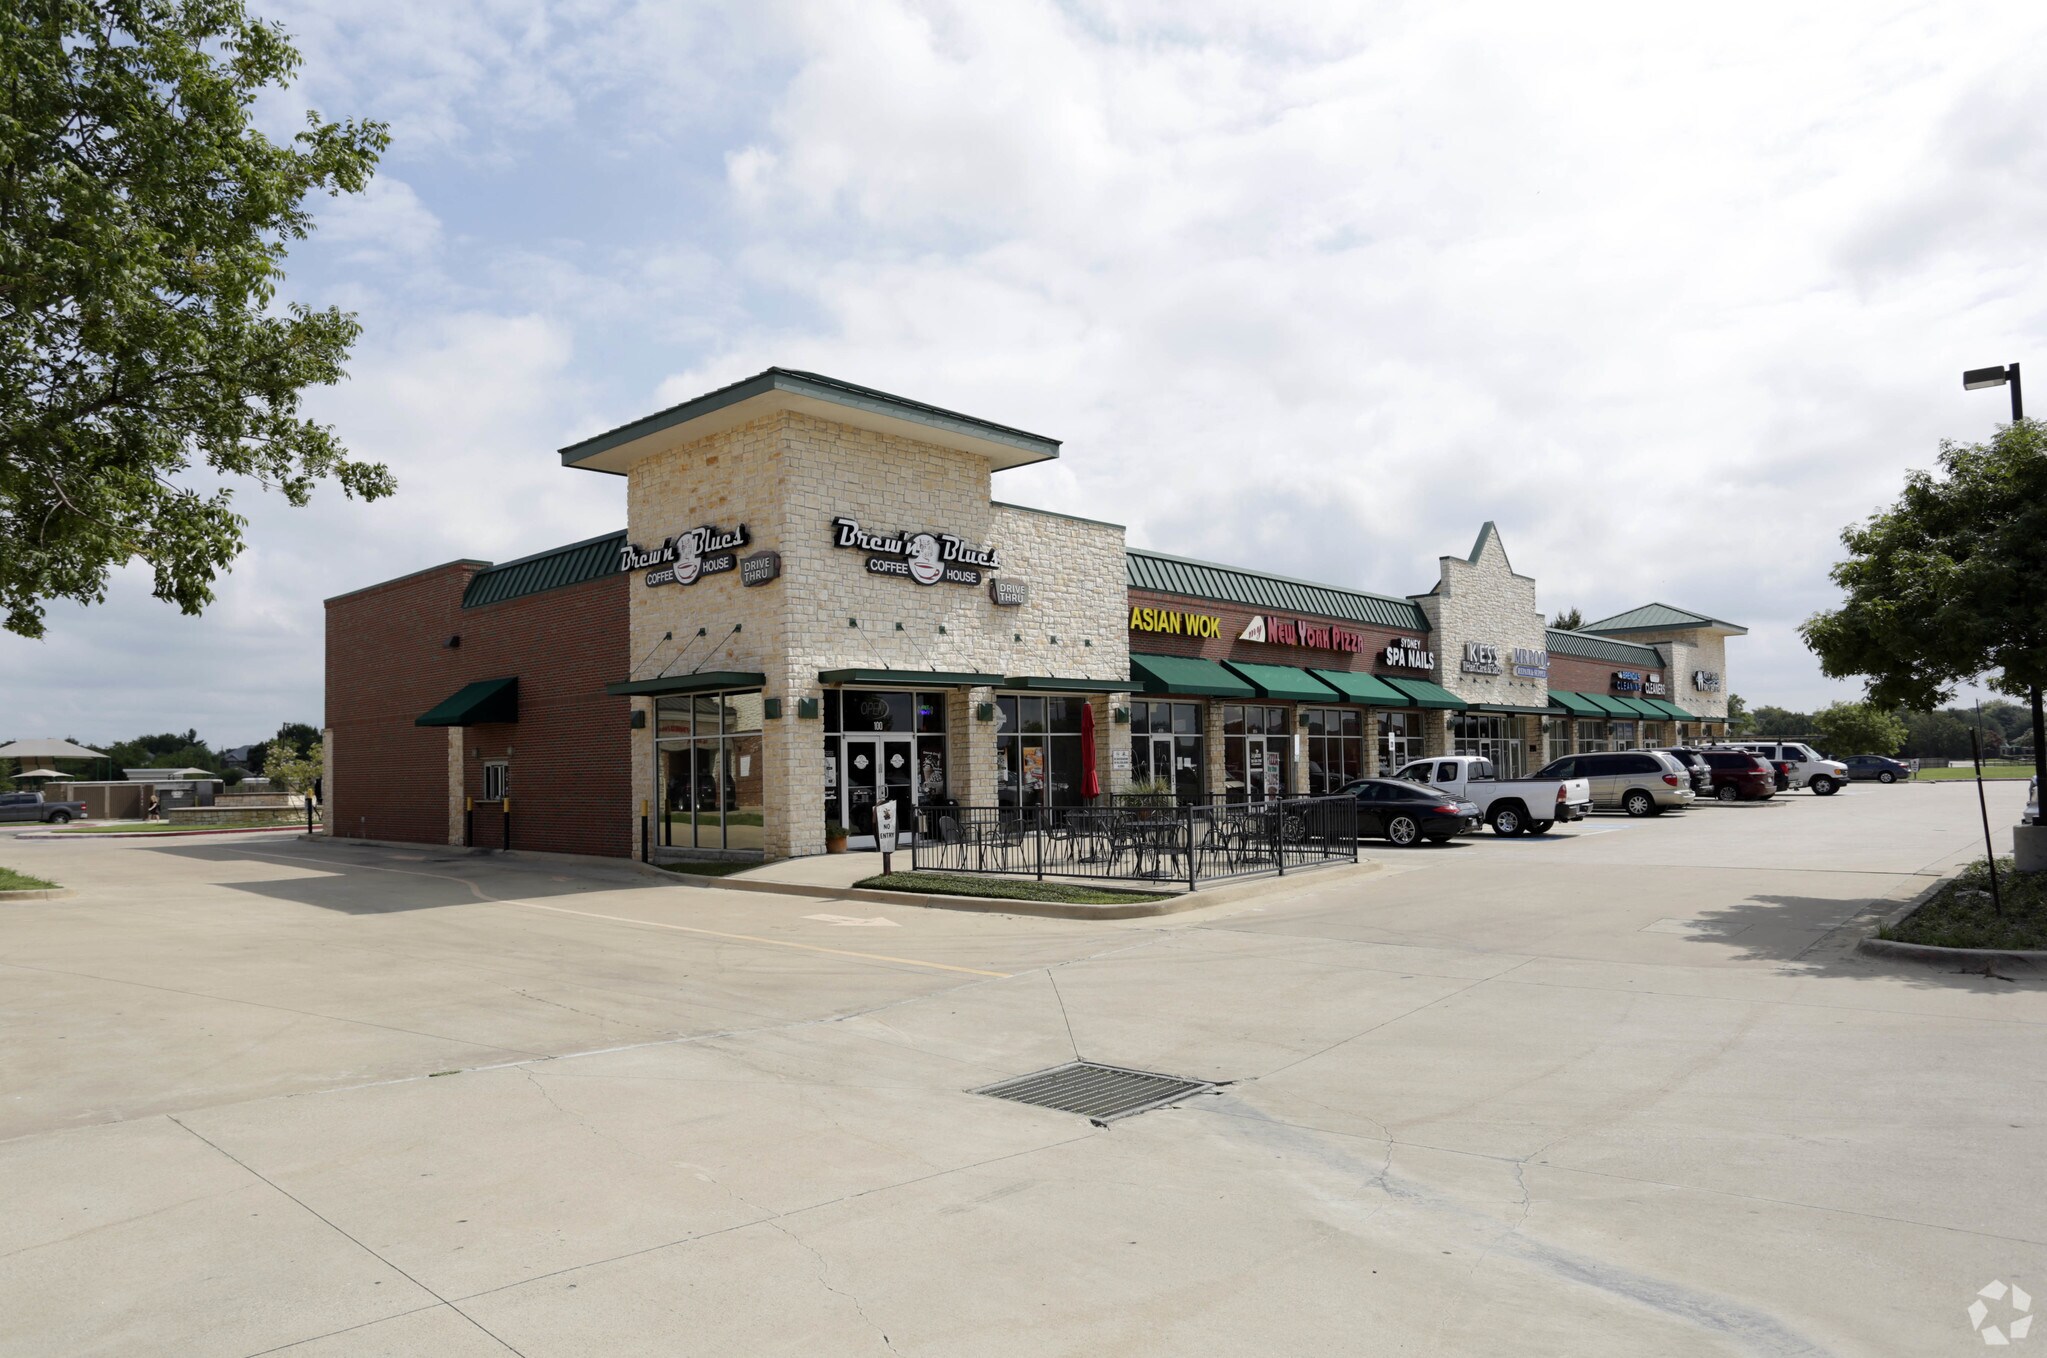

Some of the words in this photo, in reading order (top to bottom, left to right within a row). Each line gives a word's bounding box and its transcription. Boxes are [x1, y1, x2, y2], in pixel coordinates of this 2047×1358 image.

[692, 526, 745, 556] Blues
[940, 533, 1000, 568] Blues
[646, 569, 674, 585] COFFEE
[702, 556, 730, 573] HOUSE
[744, 557, 770, 572] DRIVE
[870, 558, 908, 574] COFFEE
[946, 568, 977, 583] HOUSE
[744, 568, 768, 582] THRU
[999, 583, 1025, 595] DRIVE
[999, 592, 1024, 603] THRU
[1130, 606, 1181, 635] ASIAN
[1184, 612, 1221, 640] WOK
[1400, 637, 1421, 650] SYDNEY
[1386, 646, 1406, 667] SPA
[1408, 649, 1434, 670] NAILS
[1645, 682, 1666, 696] CLEANERS
[861, 702, 885, 716] OPEN
[880, 832, 895, 840] ENTRY
